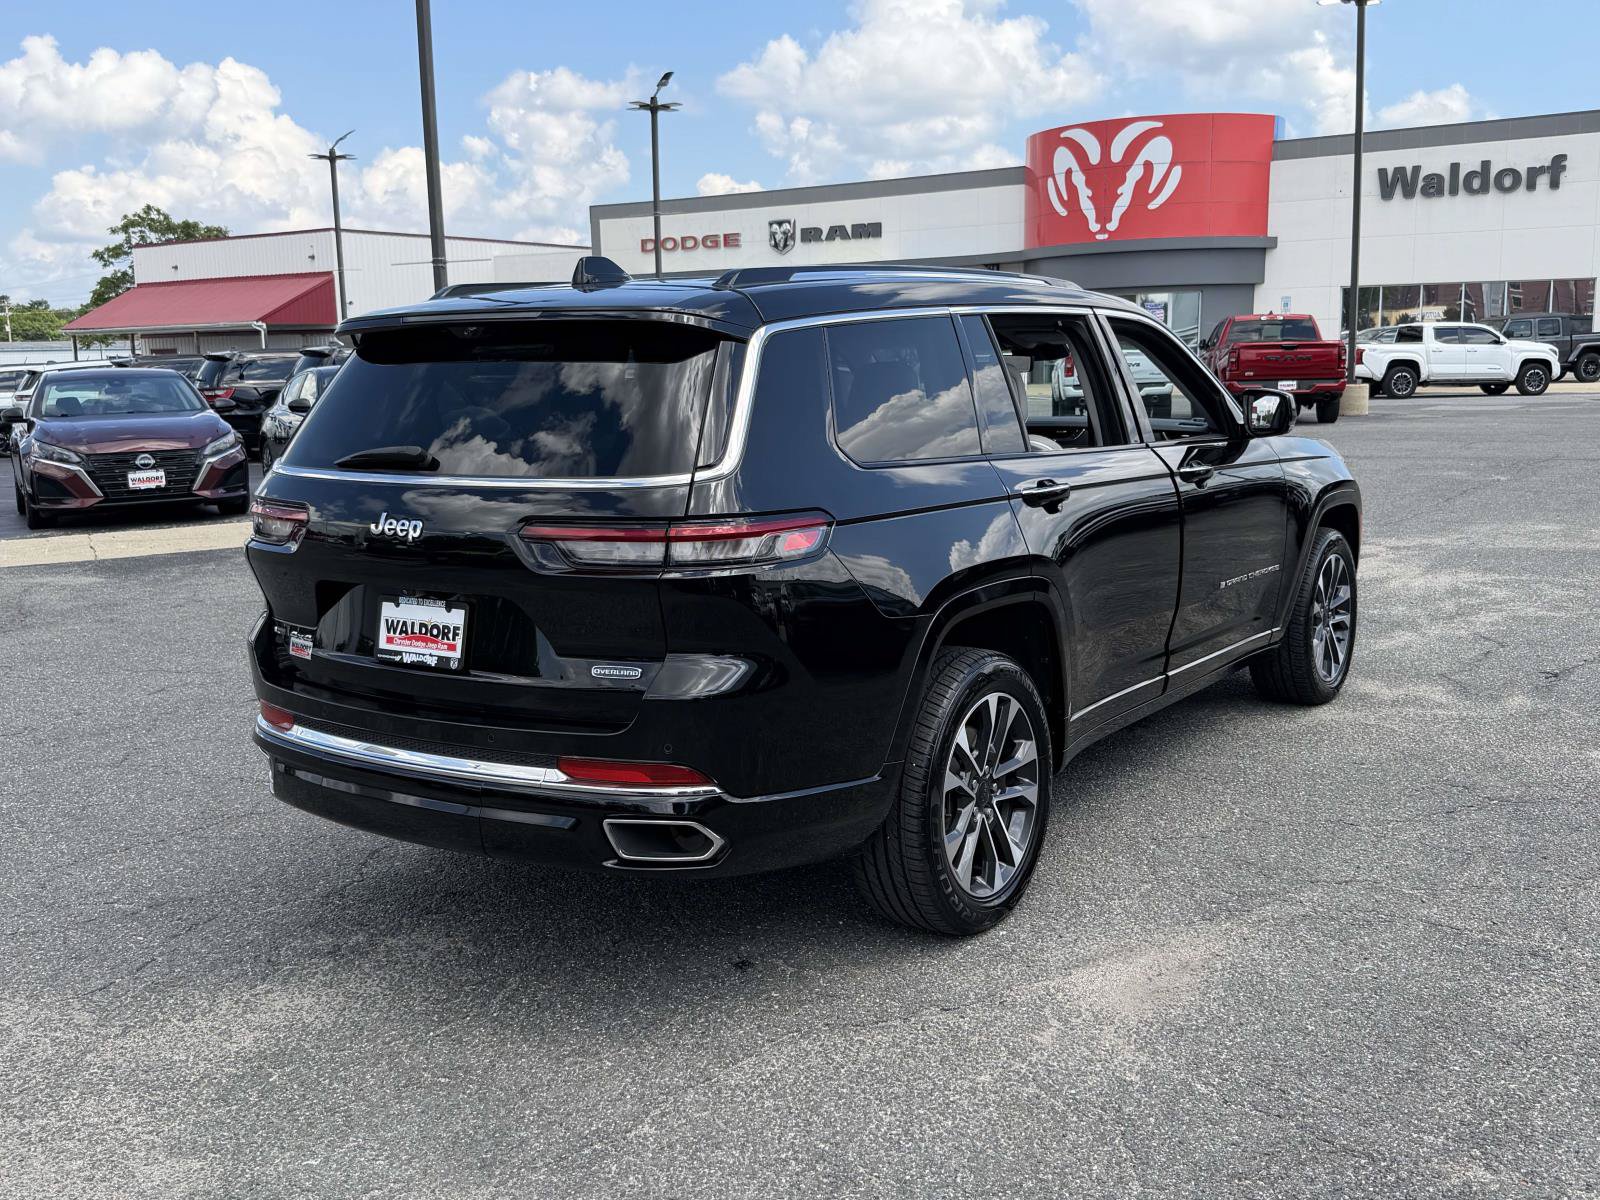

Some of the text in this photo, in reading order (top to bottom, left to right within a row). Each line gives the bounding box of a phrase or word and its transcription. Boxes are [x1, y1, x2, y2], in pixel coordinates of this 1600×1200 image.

[1378, 153, 1567, 201] Waldorf
[640, 232, 741, 253] DODGE
[800, 222, 882, 243] RAM
[130, 475, 163, 483] WALDORF
[370, 512, 423, 542] Jeep
[385, 618, 461, 642] WALDORF
[393, 638, 411, 647] Chrysler
[411, 640, 426, 649] Dodge
[426, 642, 437, 650] Jeep
[402, 652, 438, 667] WALDORF
[593, 668, 639, 677] OVERLAND
